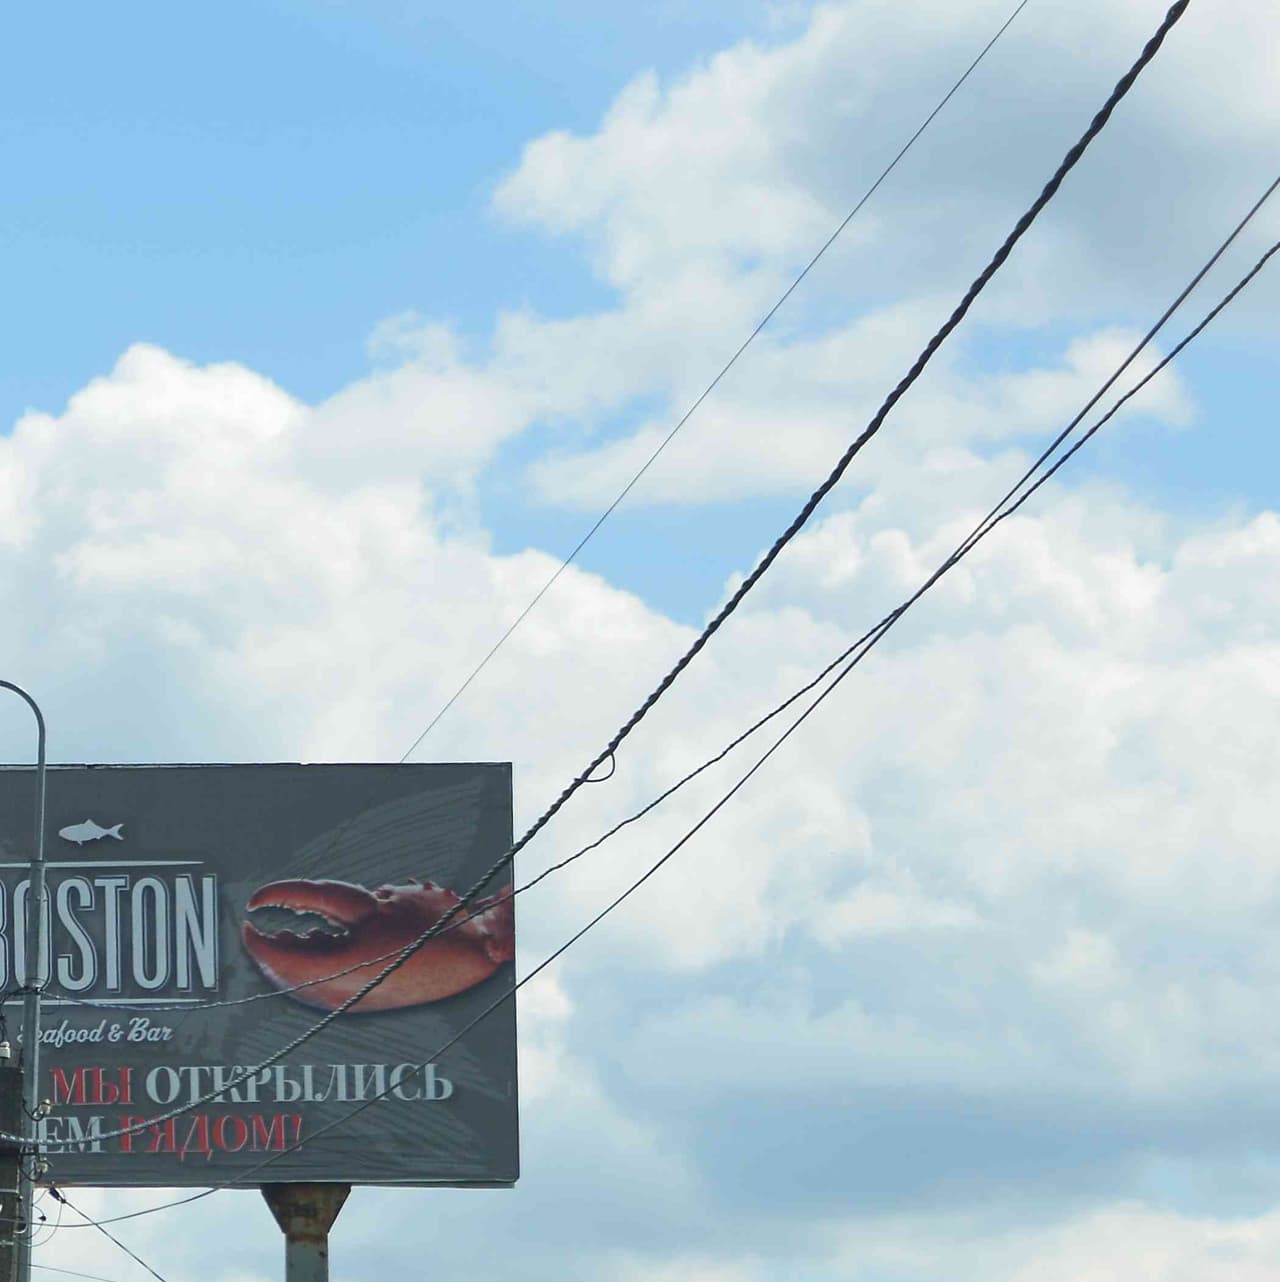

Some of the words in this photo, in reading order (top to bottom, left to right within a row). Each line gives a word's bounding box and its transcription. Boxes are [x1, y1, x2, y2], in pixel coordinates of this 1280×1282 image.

[17, 1019, 107, 1048] eafood
[108, 1023, 124, 1042] &
[128, 1016, 173, 1043] Bar
[49, 1067, 134, 1105] МЫ
[145, 1062, 453, 1104] ОТКРЫЛИСЬ
[119, 1114, 303, 1161] РЯДОМ!
